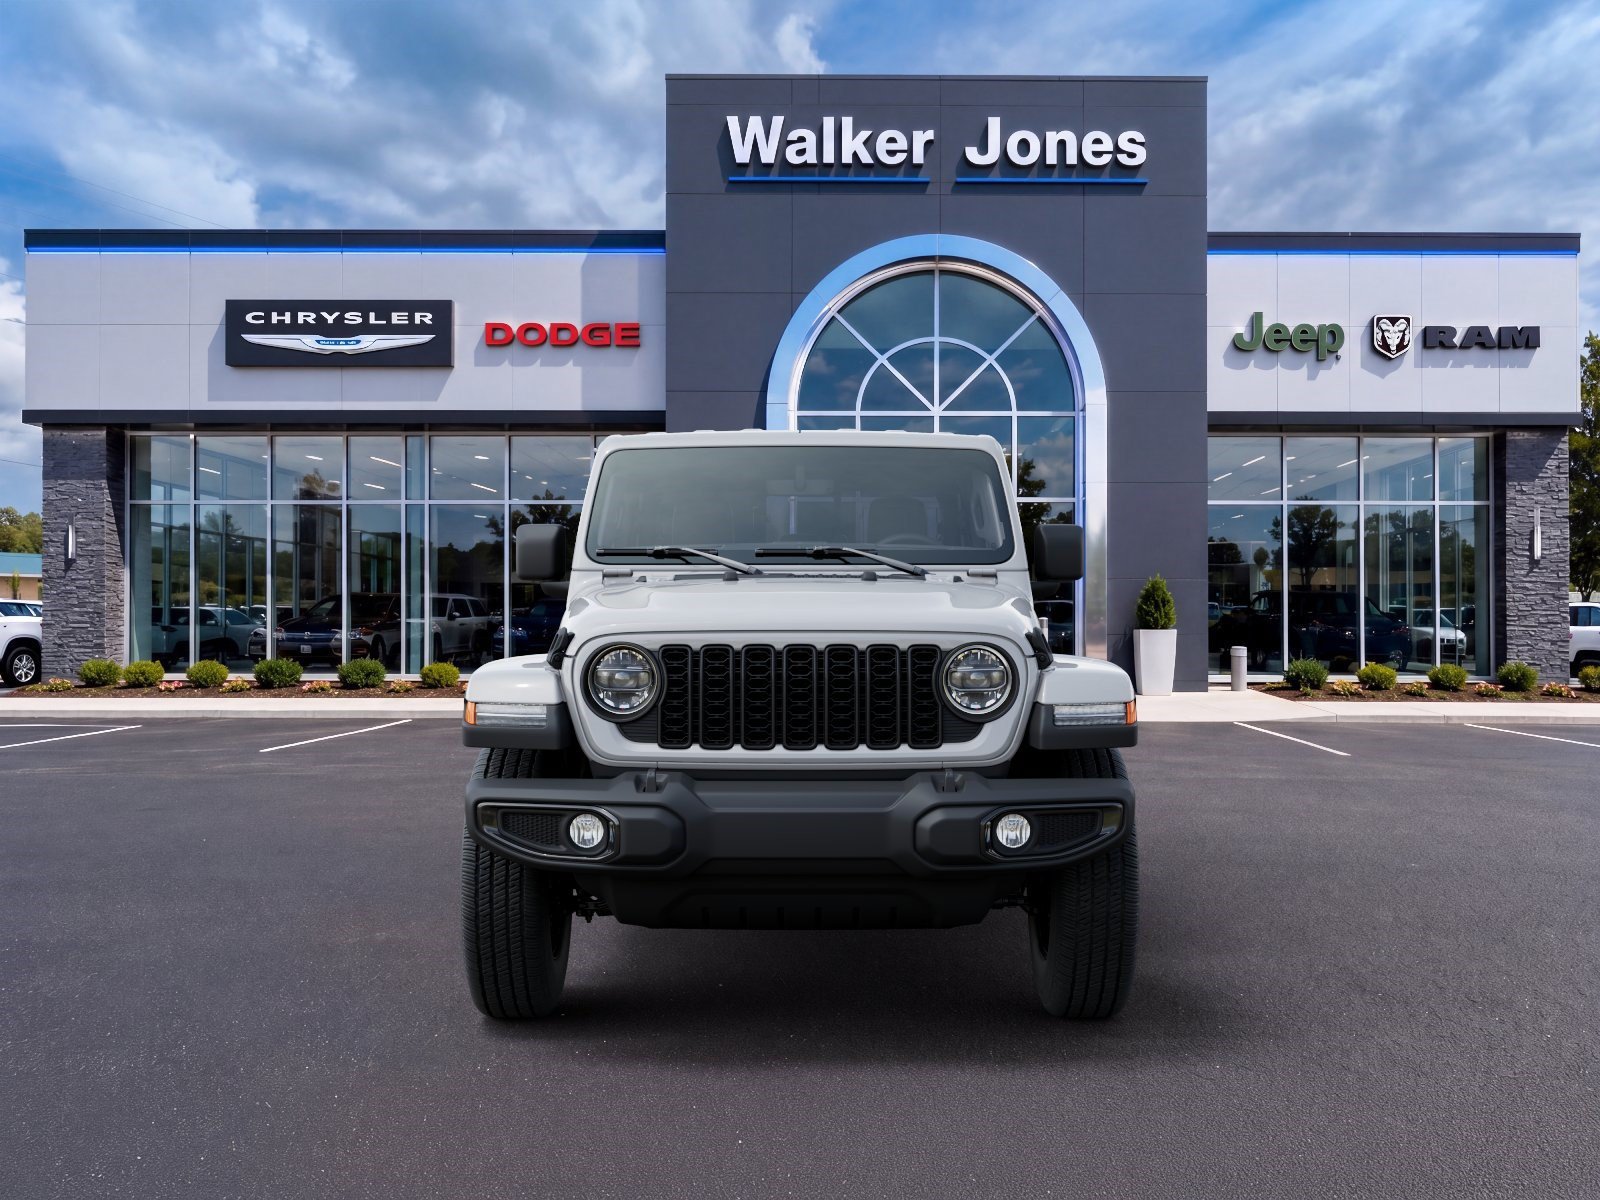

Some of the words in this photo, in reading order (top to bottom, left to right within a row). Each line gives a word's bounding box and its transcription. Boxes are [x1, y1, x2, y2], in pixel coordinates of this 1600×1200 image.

[726, 115, 934, 166] Walker
[965, 116, 1147, 166] Jones
[245, 311, 433, 325] CHRYSLER
[485, 322, 641, 347] DODGE
[1233, 311, 1345, 361] Jeep
[1423, 325, 1541, 348] RAM
